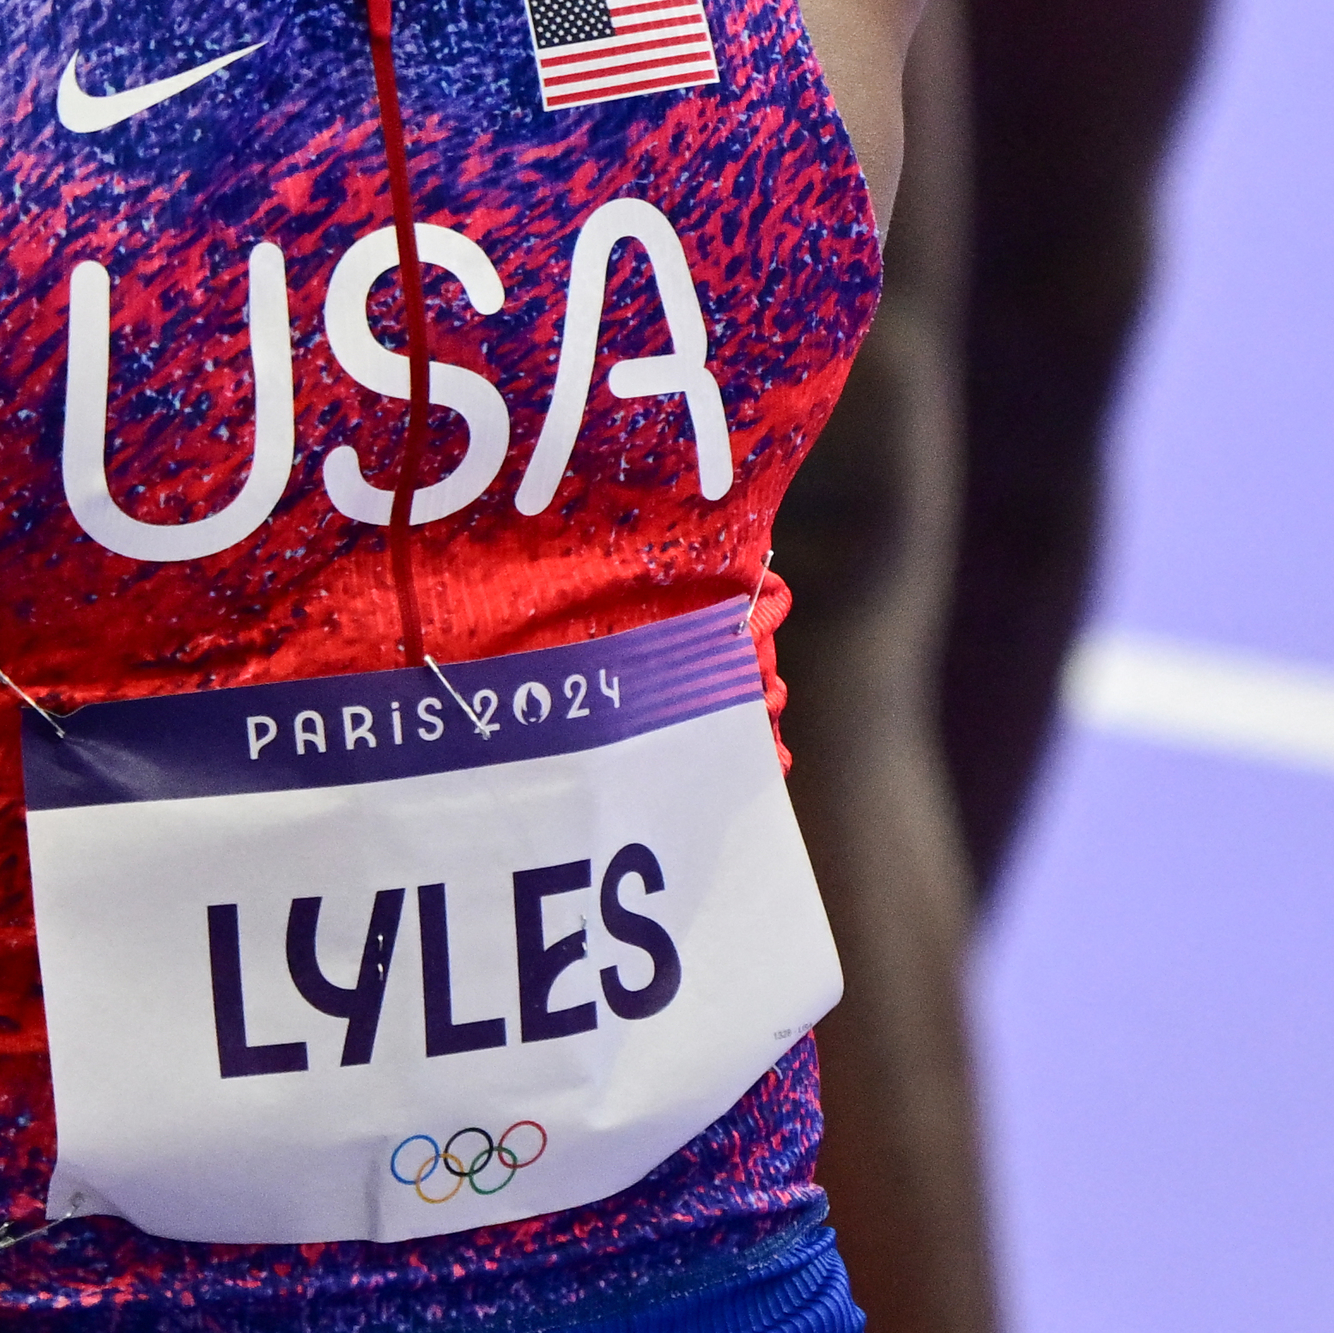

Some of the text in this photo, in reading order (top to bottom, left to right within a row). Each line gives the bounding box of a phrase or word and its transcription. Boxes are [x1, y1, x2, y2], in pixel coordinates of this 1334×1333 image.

[64, 197, 734, 562] USA
[472, 669, 620, 736] 2024
[207, 843, 682, 1079] LYLES
